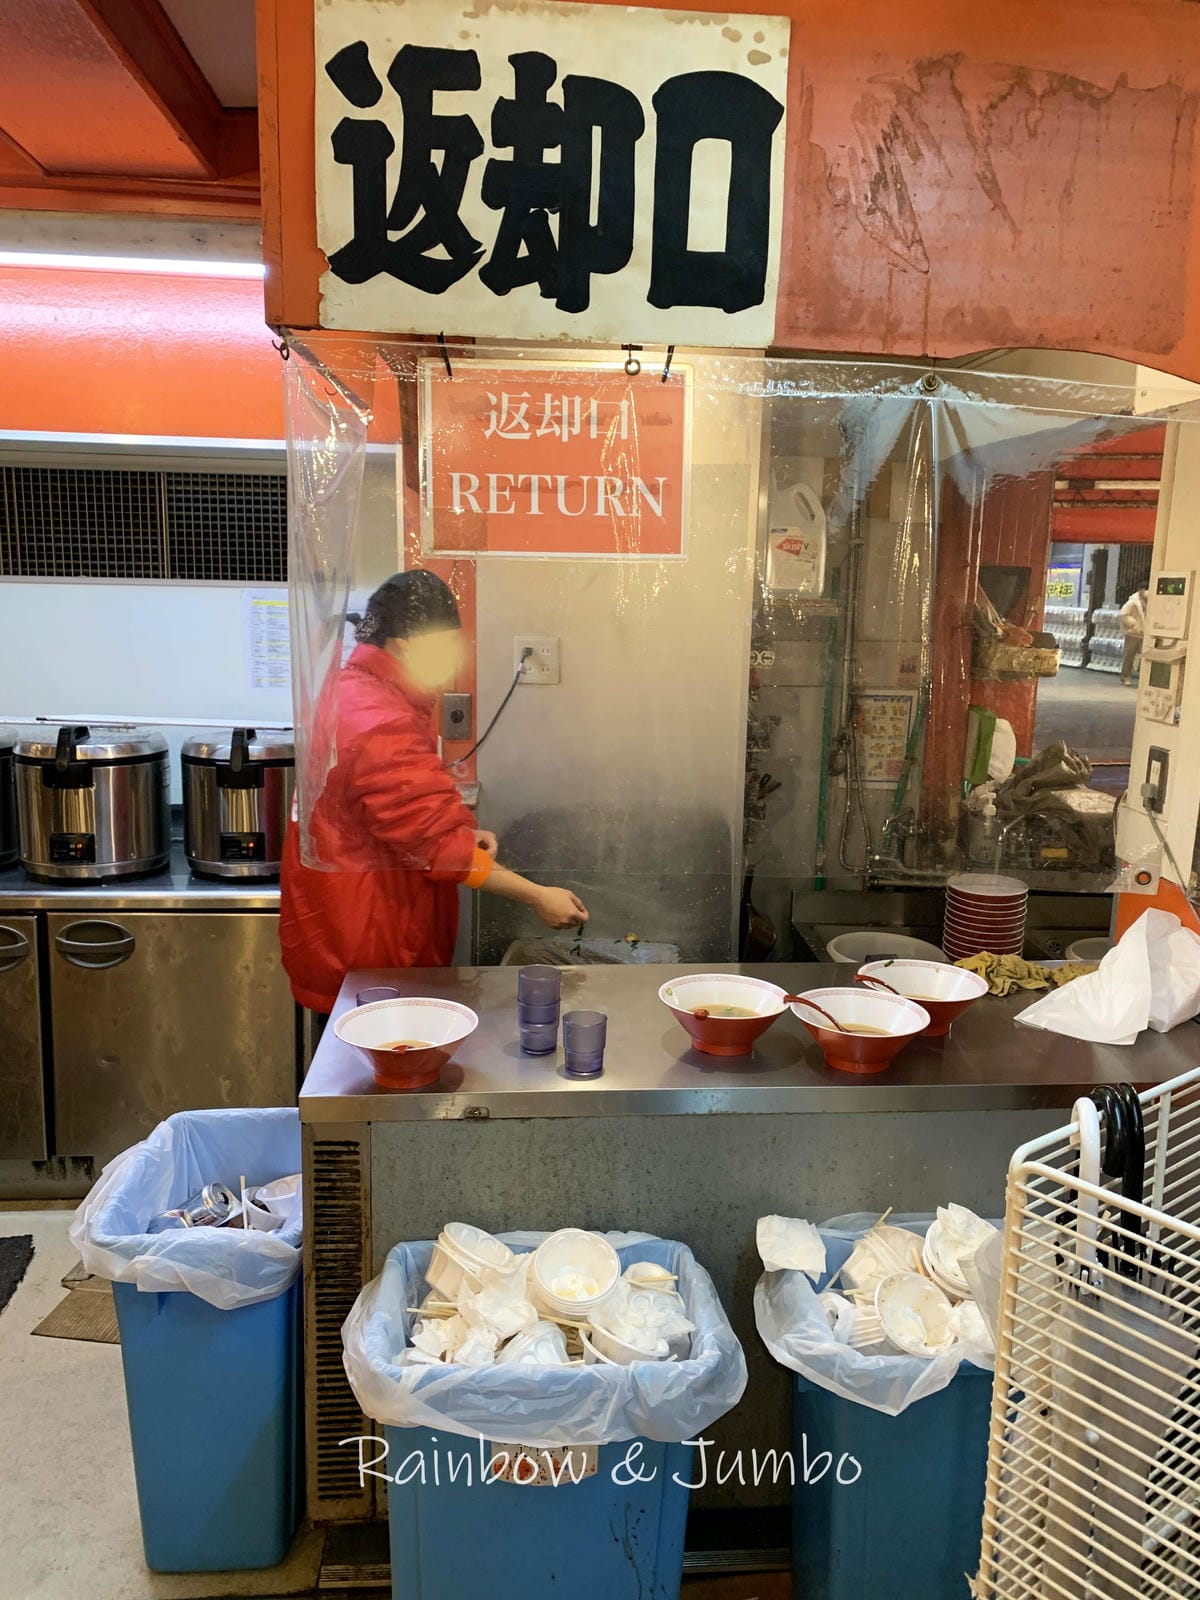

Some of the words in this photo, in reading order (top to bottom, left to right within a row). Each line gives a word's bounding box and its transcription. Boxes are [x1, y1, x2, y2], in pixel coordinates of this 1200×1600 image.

[325, 40, 785, 314] 返却口
[482, 390, 630, 443] 返却口
[449, 472, 670, 518] RETURN
